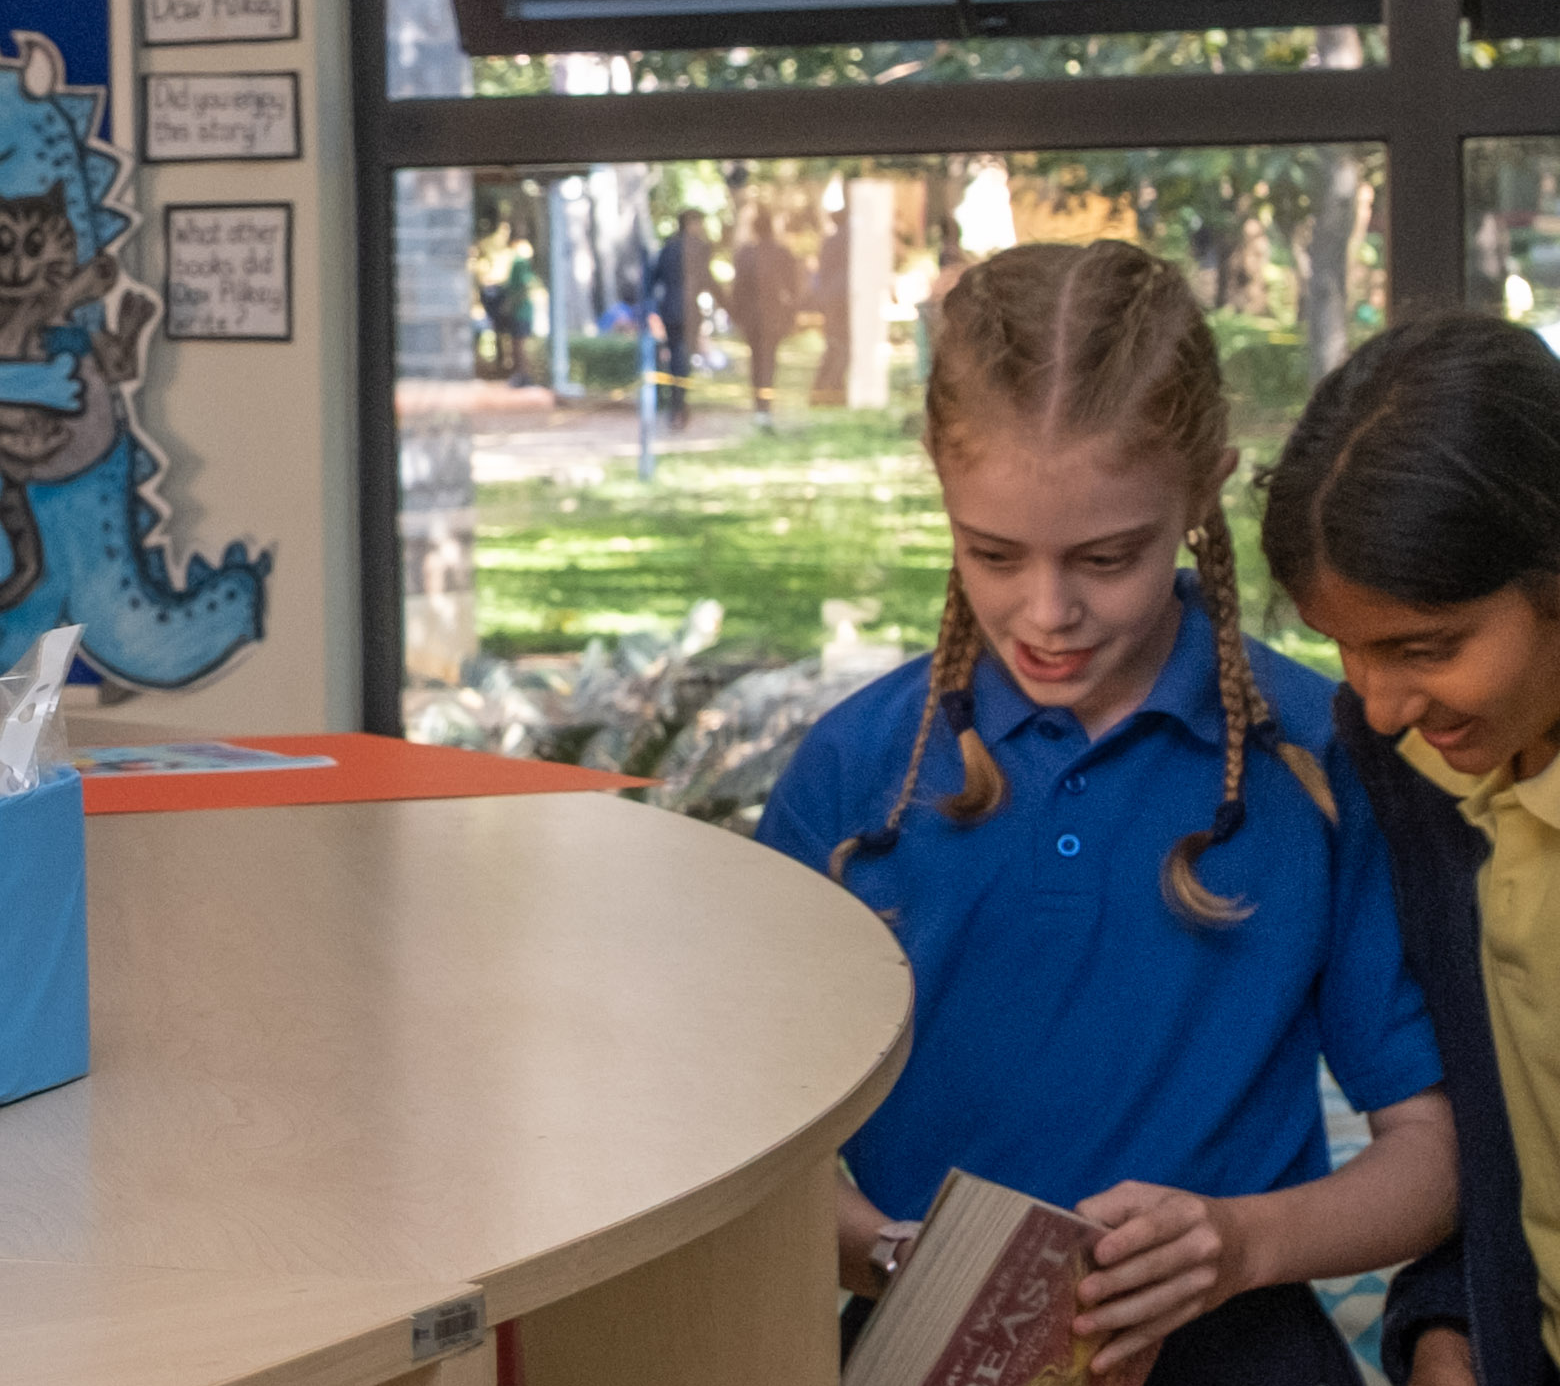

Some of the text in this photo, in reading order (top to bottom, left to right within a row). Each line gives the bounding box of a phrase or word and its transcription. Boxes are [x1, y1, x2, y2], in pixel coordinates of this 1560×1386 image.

[155, 80, 188, 109] Did
[227, 222, 278, 245] other
[174, 246, 274, 279] books did
